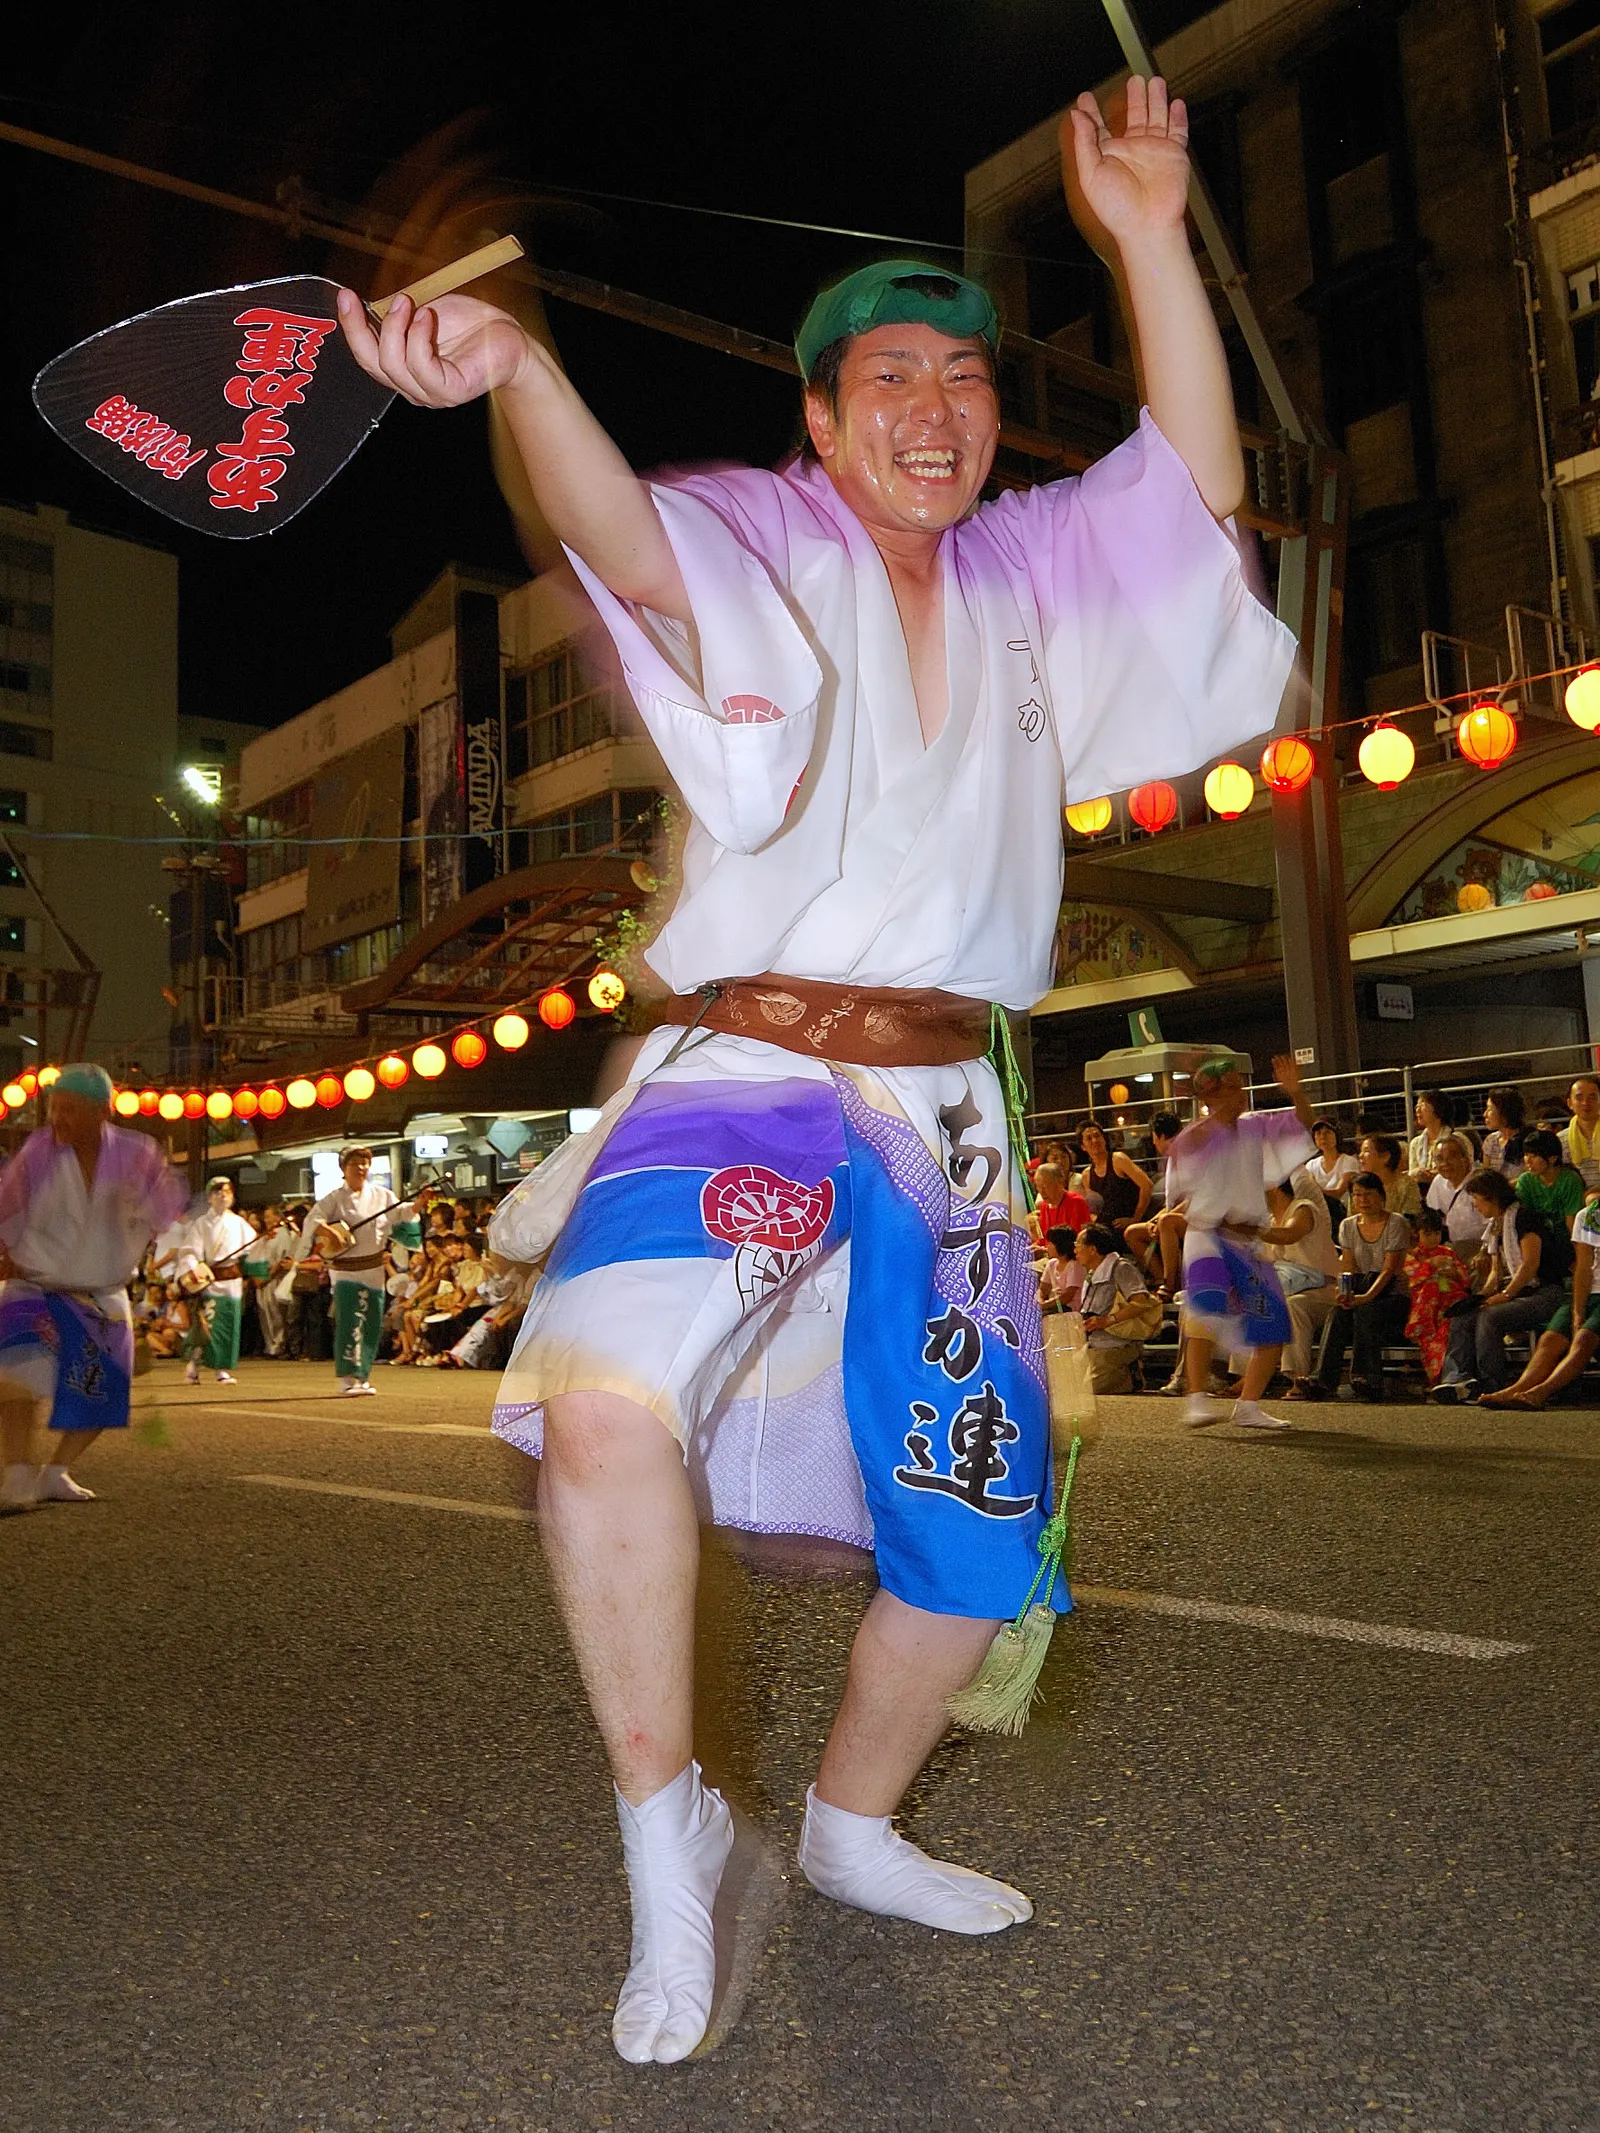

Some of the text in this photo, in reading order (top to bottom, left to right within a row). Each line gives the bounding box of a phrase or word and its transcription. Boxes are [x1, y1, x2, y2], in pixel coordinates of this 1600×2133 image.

[85, 394, 209, 480] 阿波踊
[207, 307, 338, 513] あすか連
[892, 1086, 1039, 1520] あすか連
